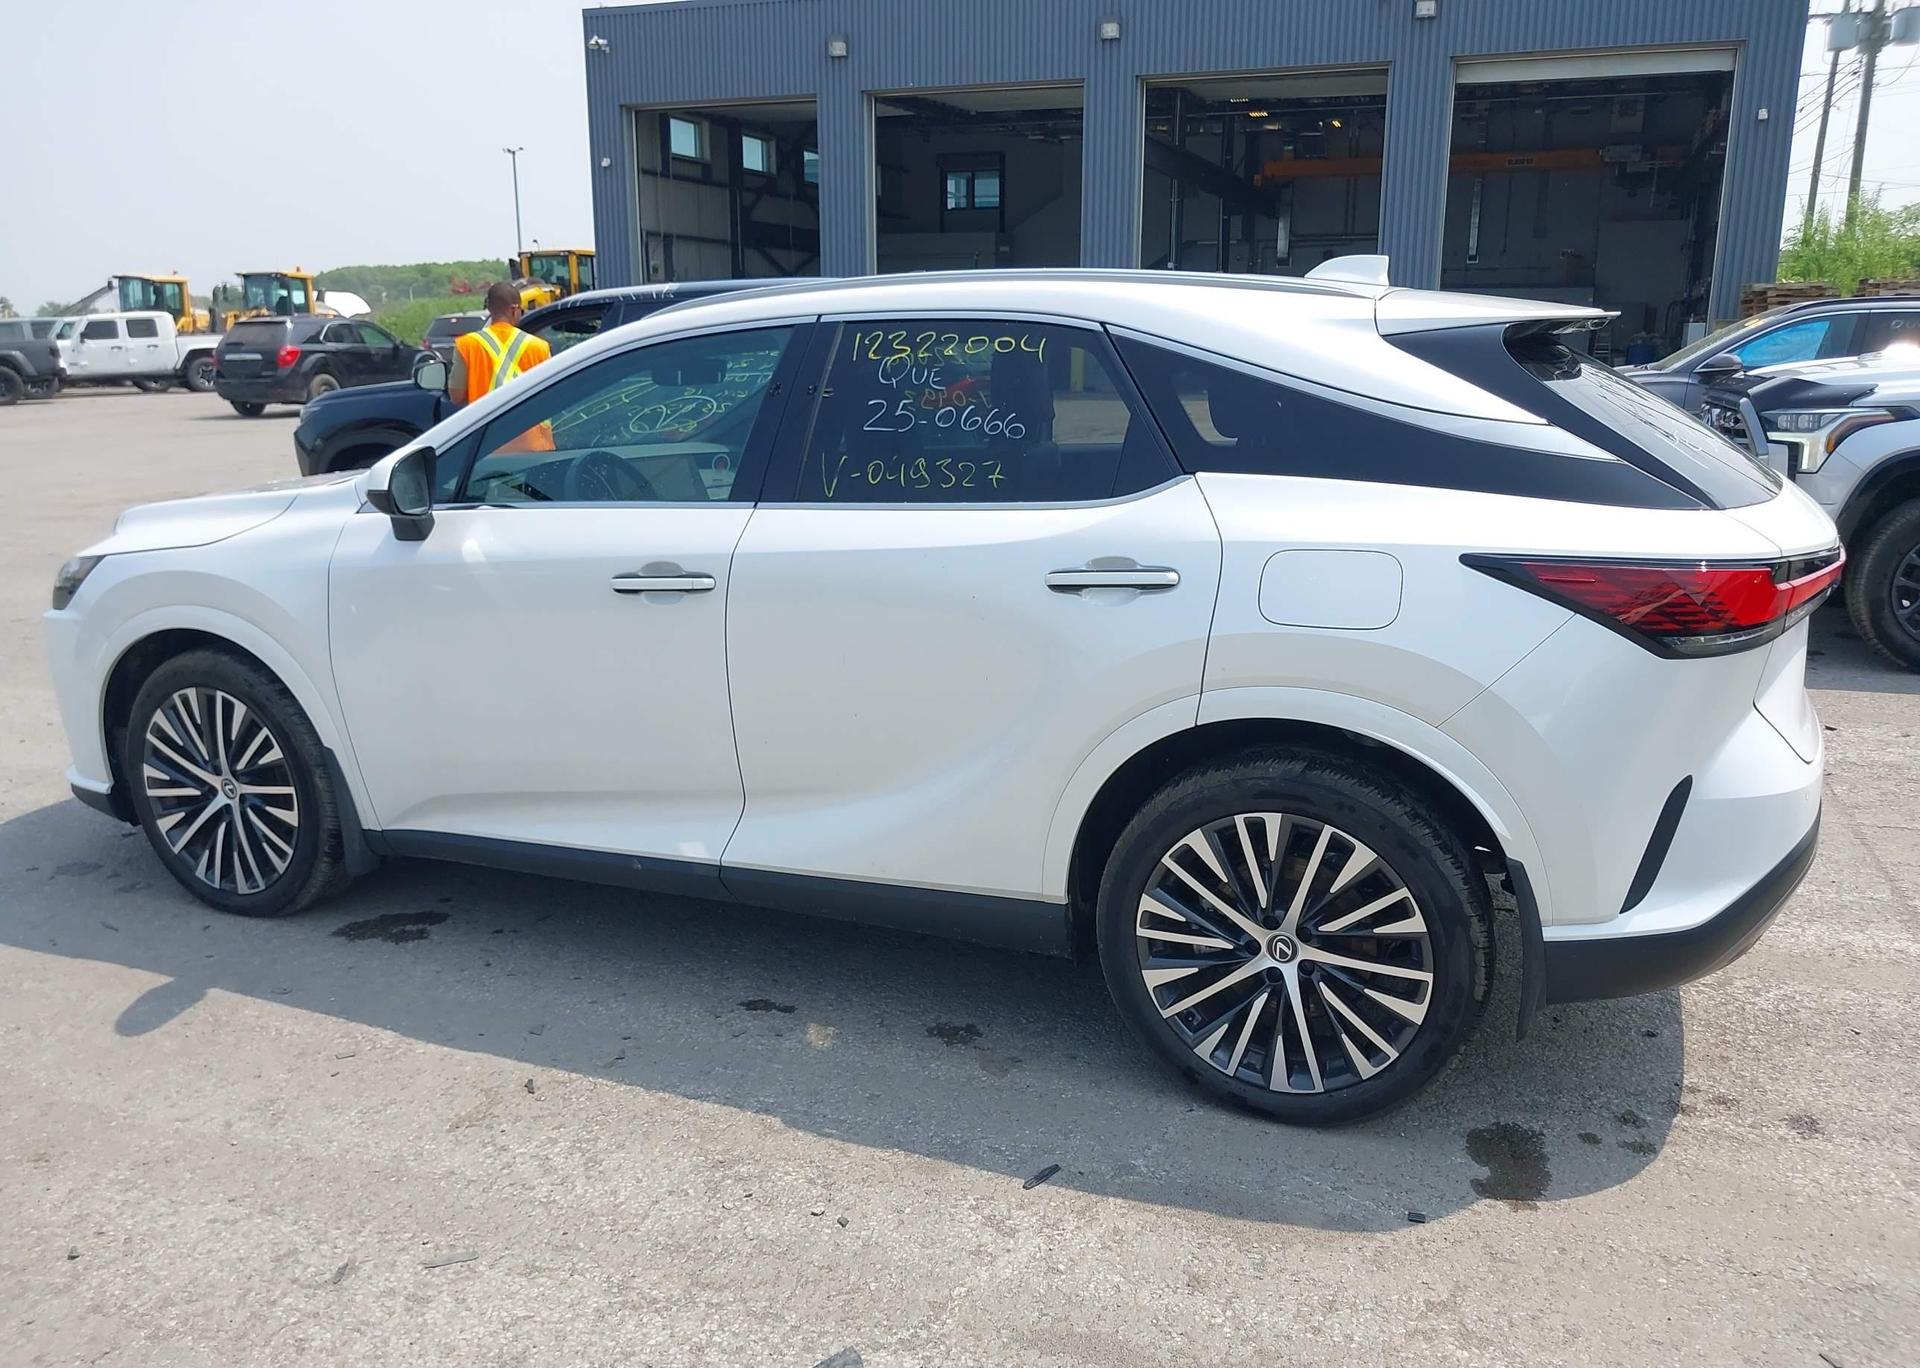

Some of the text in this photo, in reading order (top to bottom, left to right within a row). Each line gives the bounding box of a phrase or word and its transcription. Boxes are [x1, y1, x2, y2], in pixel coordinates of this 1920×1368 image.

[852, 331, 1047, 363] 12322004
[878, 353, 947, 389] QUE
[862, 399, 1026, 439] 25-0666
